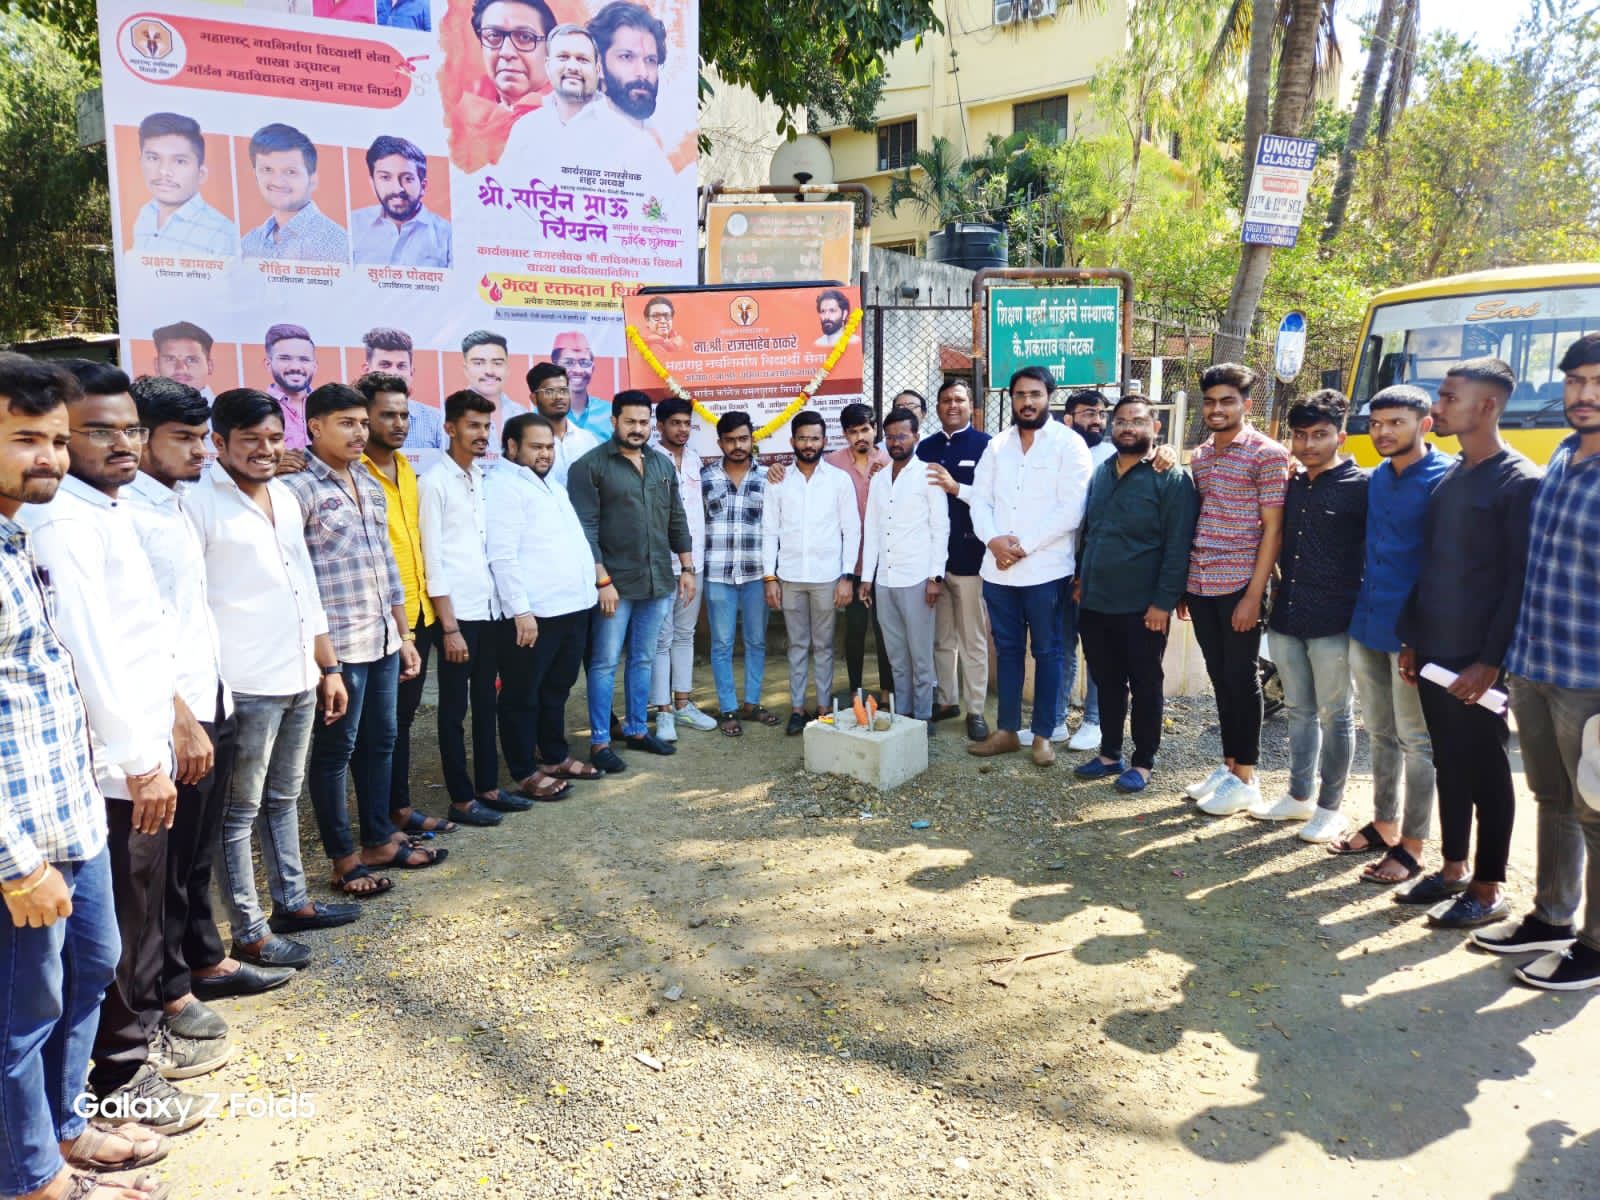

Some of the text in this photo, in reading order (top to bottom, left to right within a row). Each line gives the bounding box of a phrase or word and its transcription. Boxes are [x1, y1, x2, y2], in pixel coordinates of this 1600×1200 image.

[253, 37, 312, 54] नवनिर्माण
[366, 50, 391, 64] सेना
[255, 55, 290, 68] शाखा
[226, 68, 296, 86] महाविद्यालय
[300, 77, 333, 92] यमुना
[337, 81, 363, 93] नगर
[367, 83, 402, 98] निगडी
[1263, 138, 1316, 158] UNIQUE
[1261, 153, 1312, 169] CLASSES
[367, 265, 403, 283] सुशील
[502, 278, 538, 294] भव्य
[544, 281, 605, 299] रक्तदान
[997, 299, 1023, 327] शिक्षण
[1079, 298, 1115, 325] संस्थापक
[1466, 300, 1541, 321] Sai
[727, 336, 770, 352] राजसाहेब
[771, 334, 797, 349] ठाकरे
